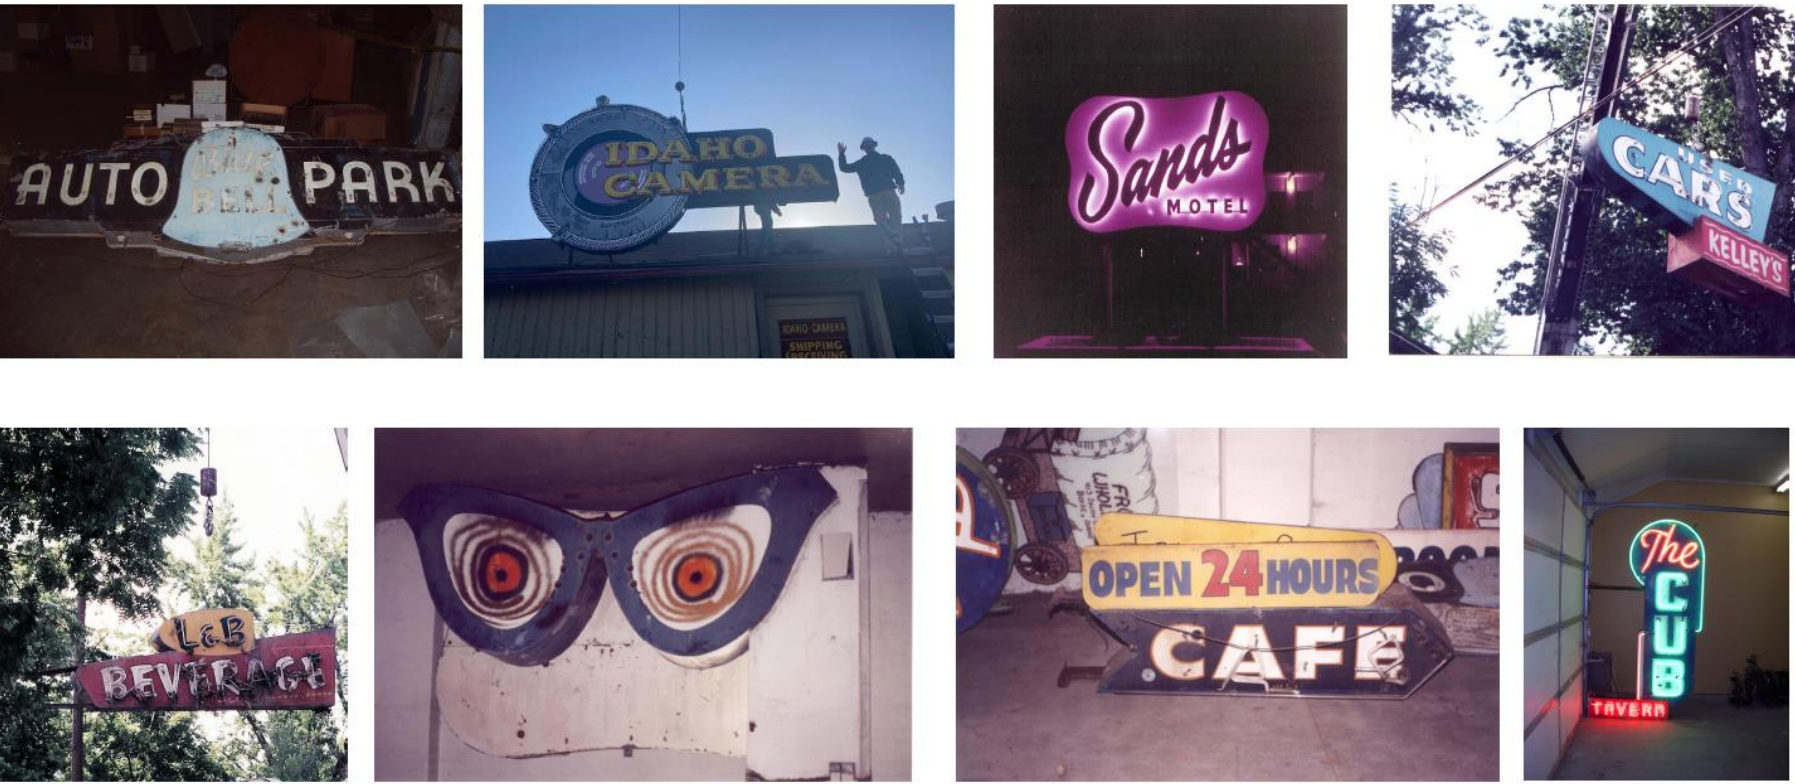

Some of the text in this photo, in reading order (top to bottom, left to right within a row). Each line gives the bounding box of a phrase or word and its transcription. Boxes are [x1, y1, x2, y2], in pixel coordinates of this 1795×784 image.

[604, 134, 768, 167] IDAHO
[1078, 95, 1252, 223] Sands
[1678, 147, 1752, 197] USED
[15, 161, 169, 206] AUTO
[303, 160, 456, 205] PARK
[604, 164, 830, 198] CAMERA
[1612, 135, 1753, 231] CARS
[1166, 198, 1249, 215] MOTEL
[1708, 228, 1783, 285] KELLEY'S
[783, 322, 846, 334] IDAHO CAMERA
[790, 341, 843, 352] SHIPPING
[1092, 471, 1112, 514] WHOL
[1640, 524, 1700, 573] The
[1088, 559, 1192, 597] OPEN
[1200, 549, 1264, 598] 24
[1266, 557, 1380, 595] HOURS
[173, 614, 247, 650] L&B
[1150, 623, 1407, 686] CAFE
[1652, 571, 1688, 698] CUB
[100, 652, 326, 700] BEVERAGE
[1591, 700, 1666, 718] TAVERN
